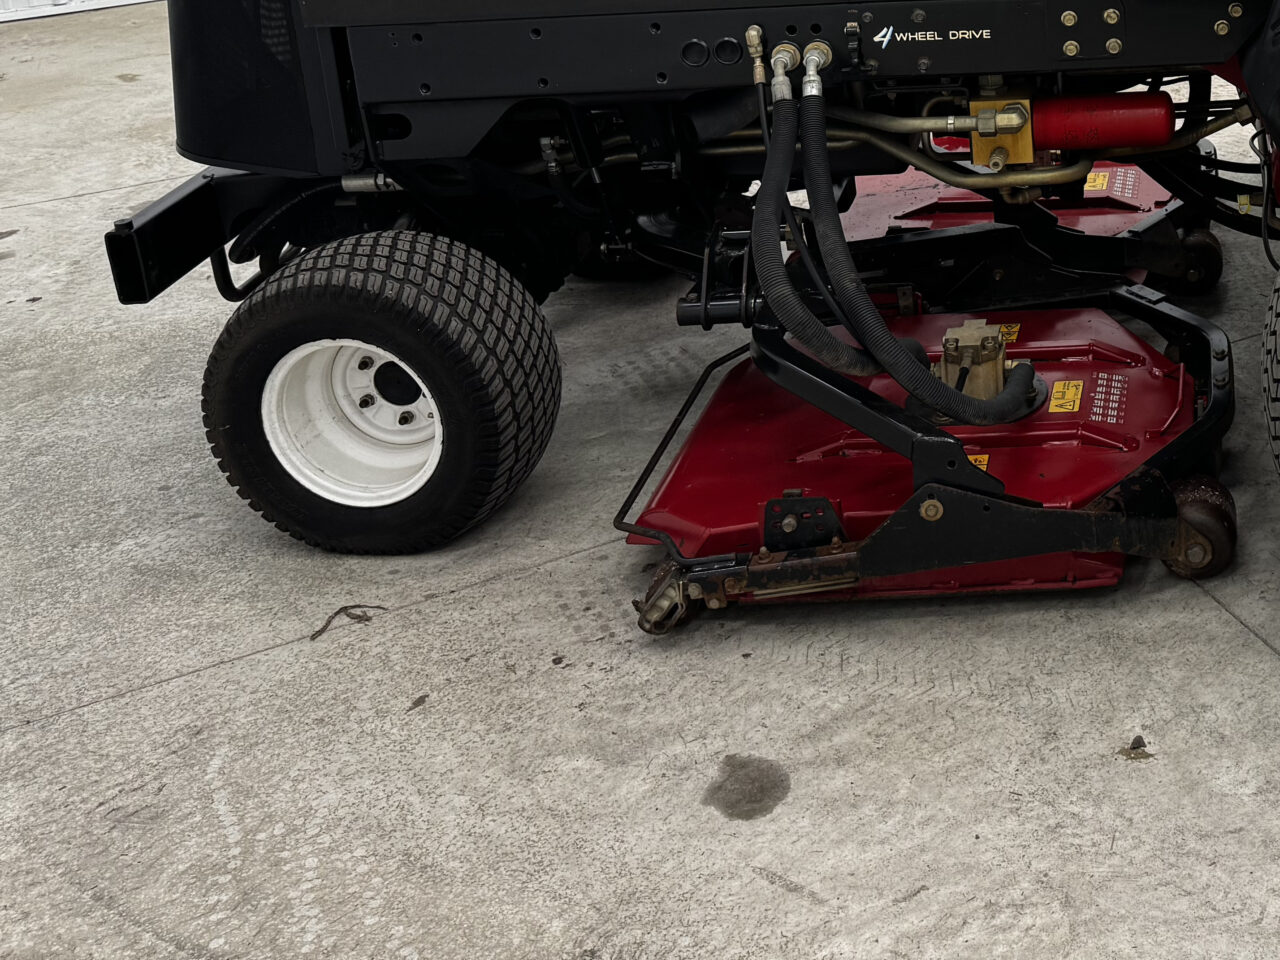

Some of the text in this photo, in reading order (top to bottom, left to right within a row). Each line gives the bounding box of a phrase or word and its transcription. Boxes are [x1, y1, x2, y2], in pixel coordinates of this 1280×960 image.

[873, 25, 992, 50] 4 WHEEL DRIVE
